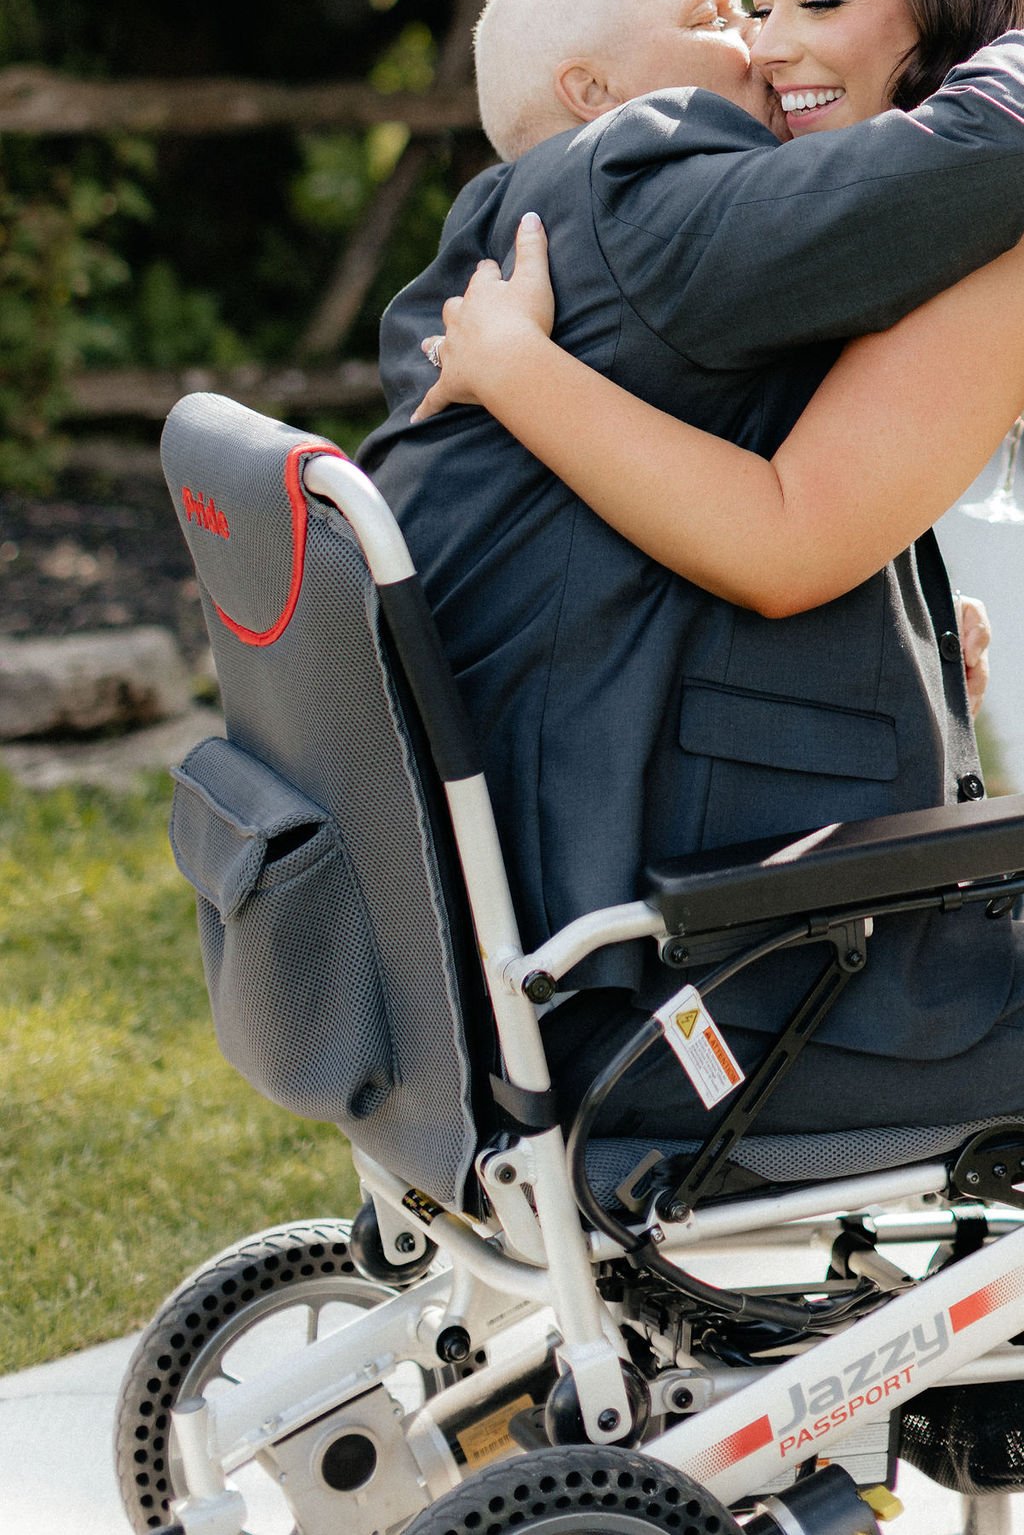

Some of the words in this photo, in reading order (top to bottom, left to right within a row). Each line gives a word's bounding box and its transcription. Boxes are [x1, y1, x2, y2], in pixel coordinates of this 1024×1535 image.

[182, 486, 230, 540] Pride
[711, 1038, 737, 1083] ATTENTION
[779, 1312, 950, 1434] Jazzy
[779, 1365, 917, 1457] PASSPORT
